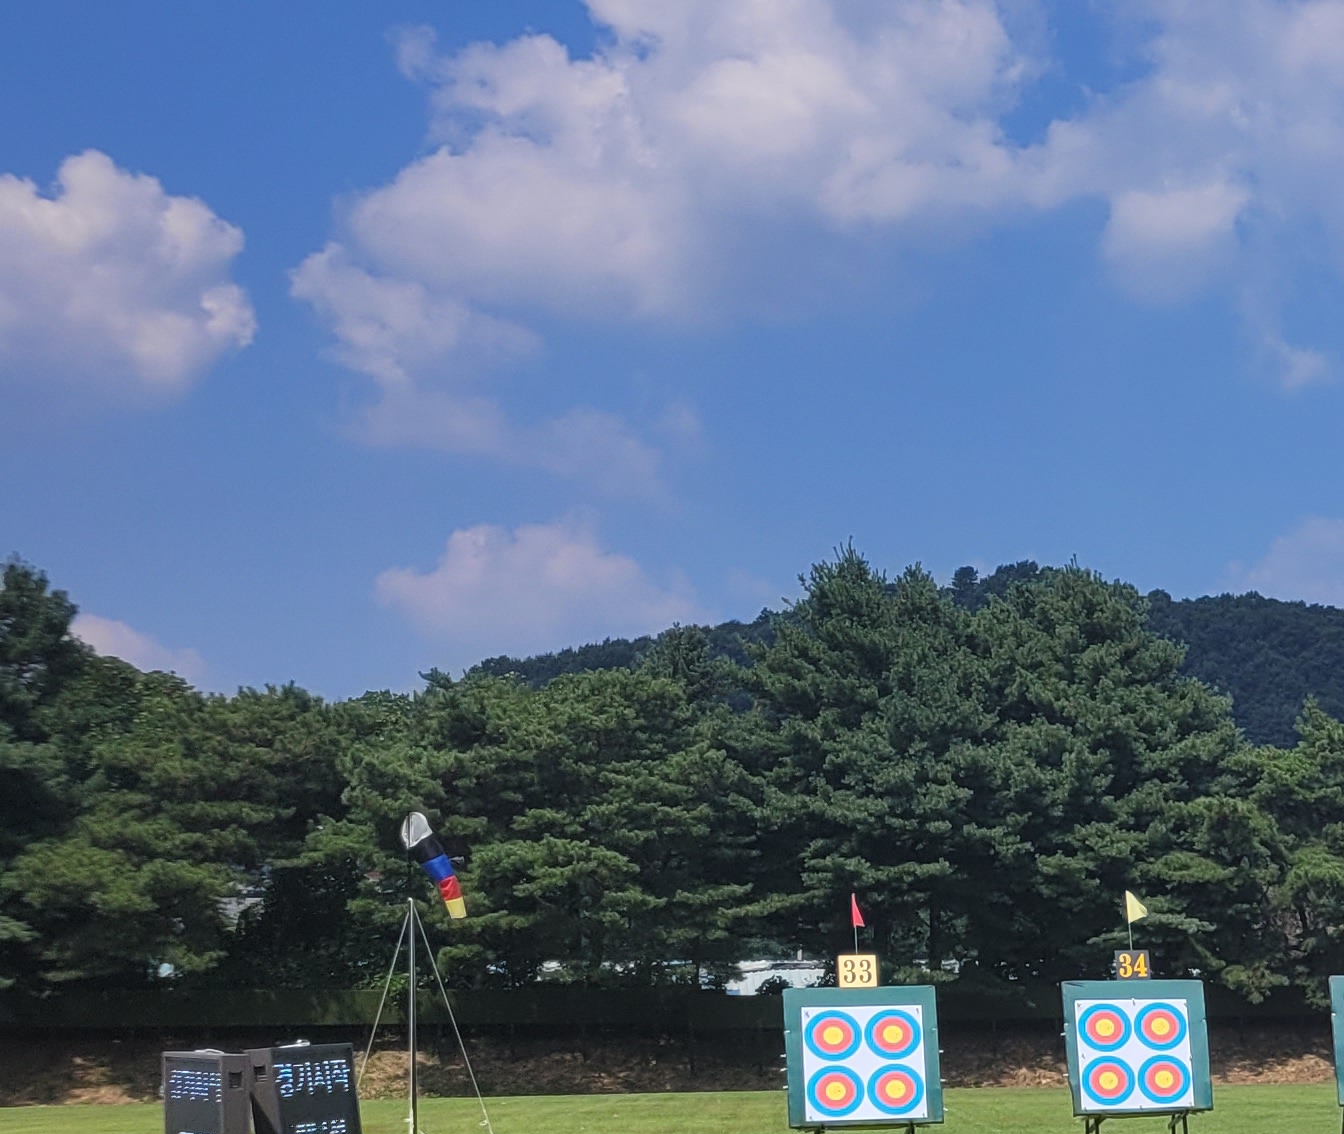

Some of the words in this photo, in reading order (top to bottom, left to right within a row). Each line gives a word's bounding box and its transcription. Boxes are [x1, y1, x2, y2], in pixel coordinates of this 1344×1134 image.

[843, 959, 872, 983] 33
[1119, 953, 1148, 978] 34
[273, 1059, 350, 1098] 경기시작
